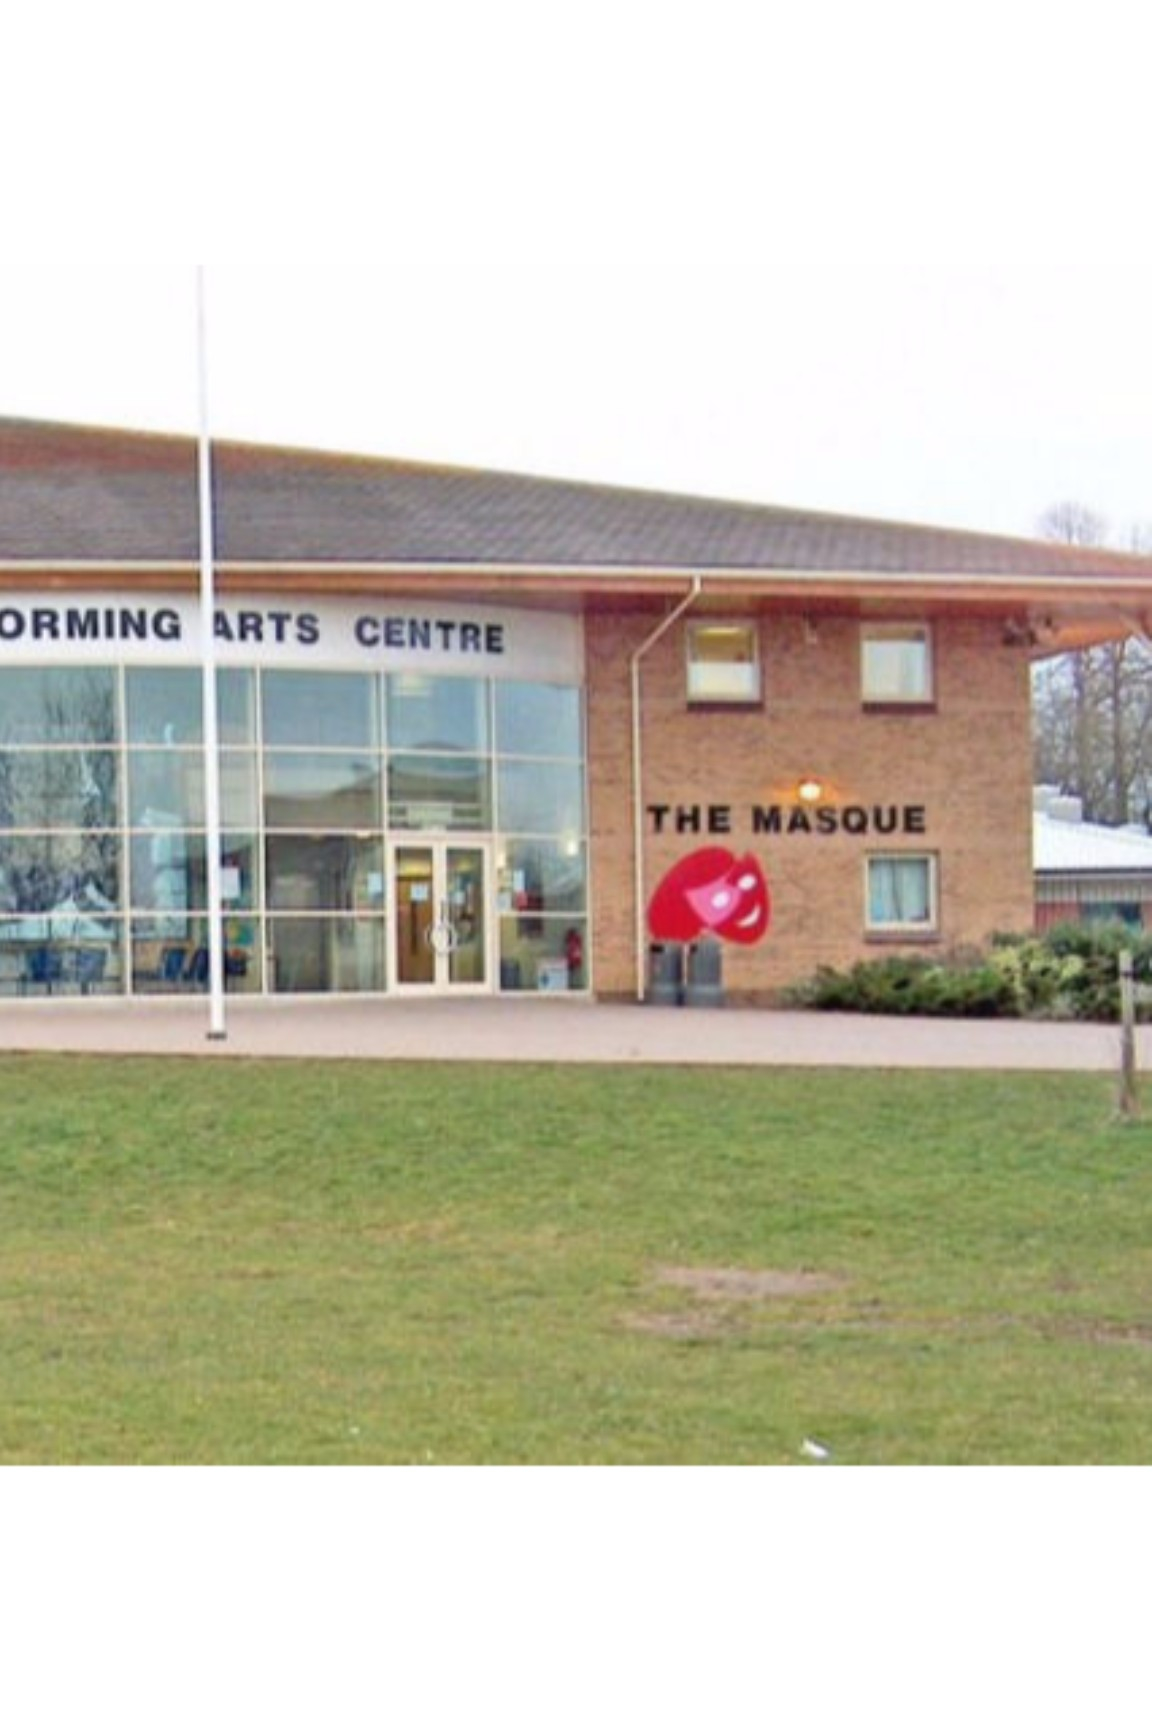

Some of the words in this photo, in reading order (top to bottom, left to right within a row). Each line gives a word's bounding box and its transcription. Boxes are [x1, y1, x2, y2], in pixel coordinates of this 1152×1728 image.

[212, 610, 320, 645] ARTS
[355, 614, 505, 654] CENTRE
[647, 804, 731, 834] THE
[752, 804, 926, 834] MASQUE
